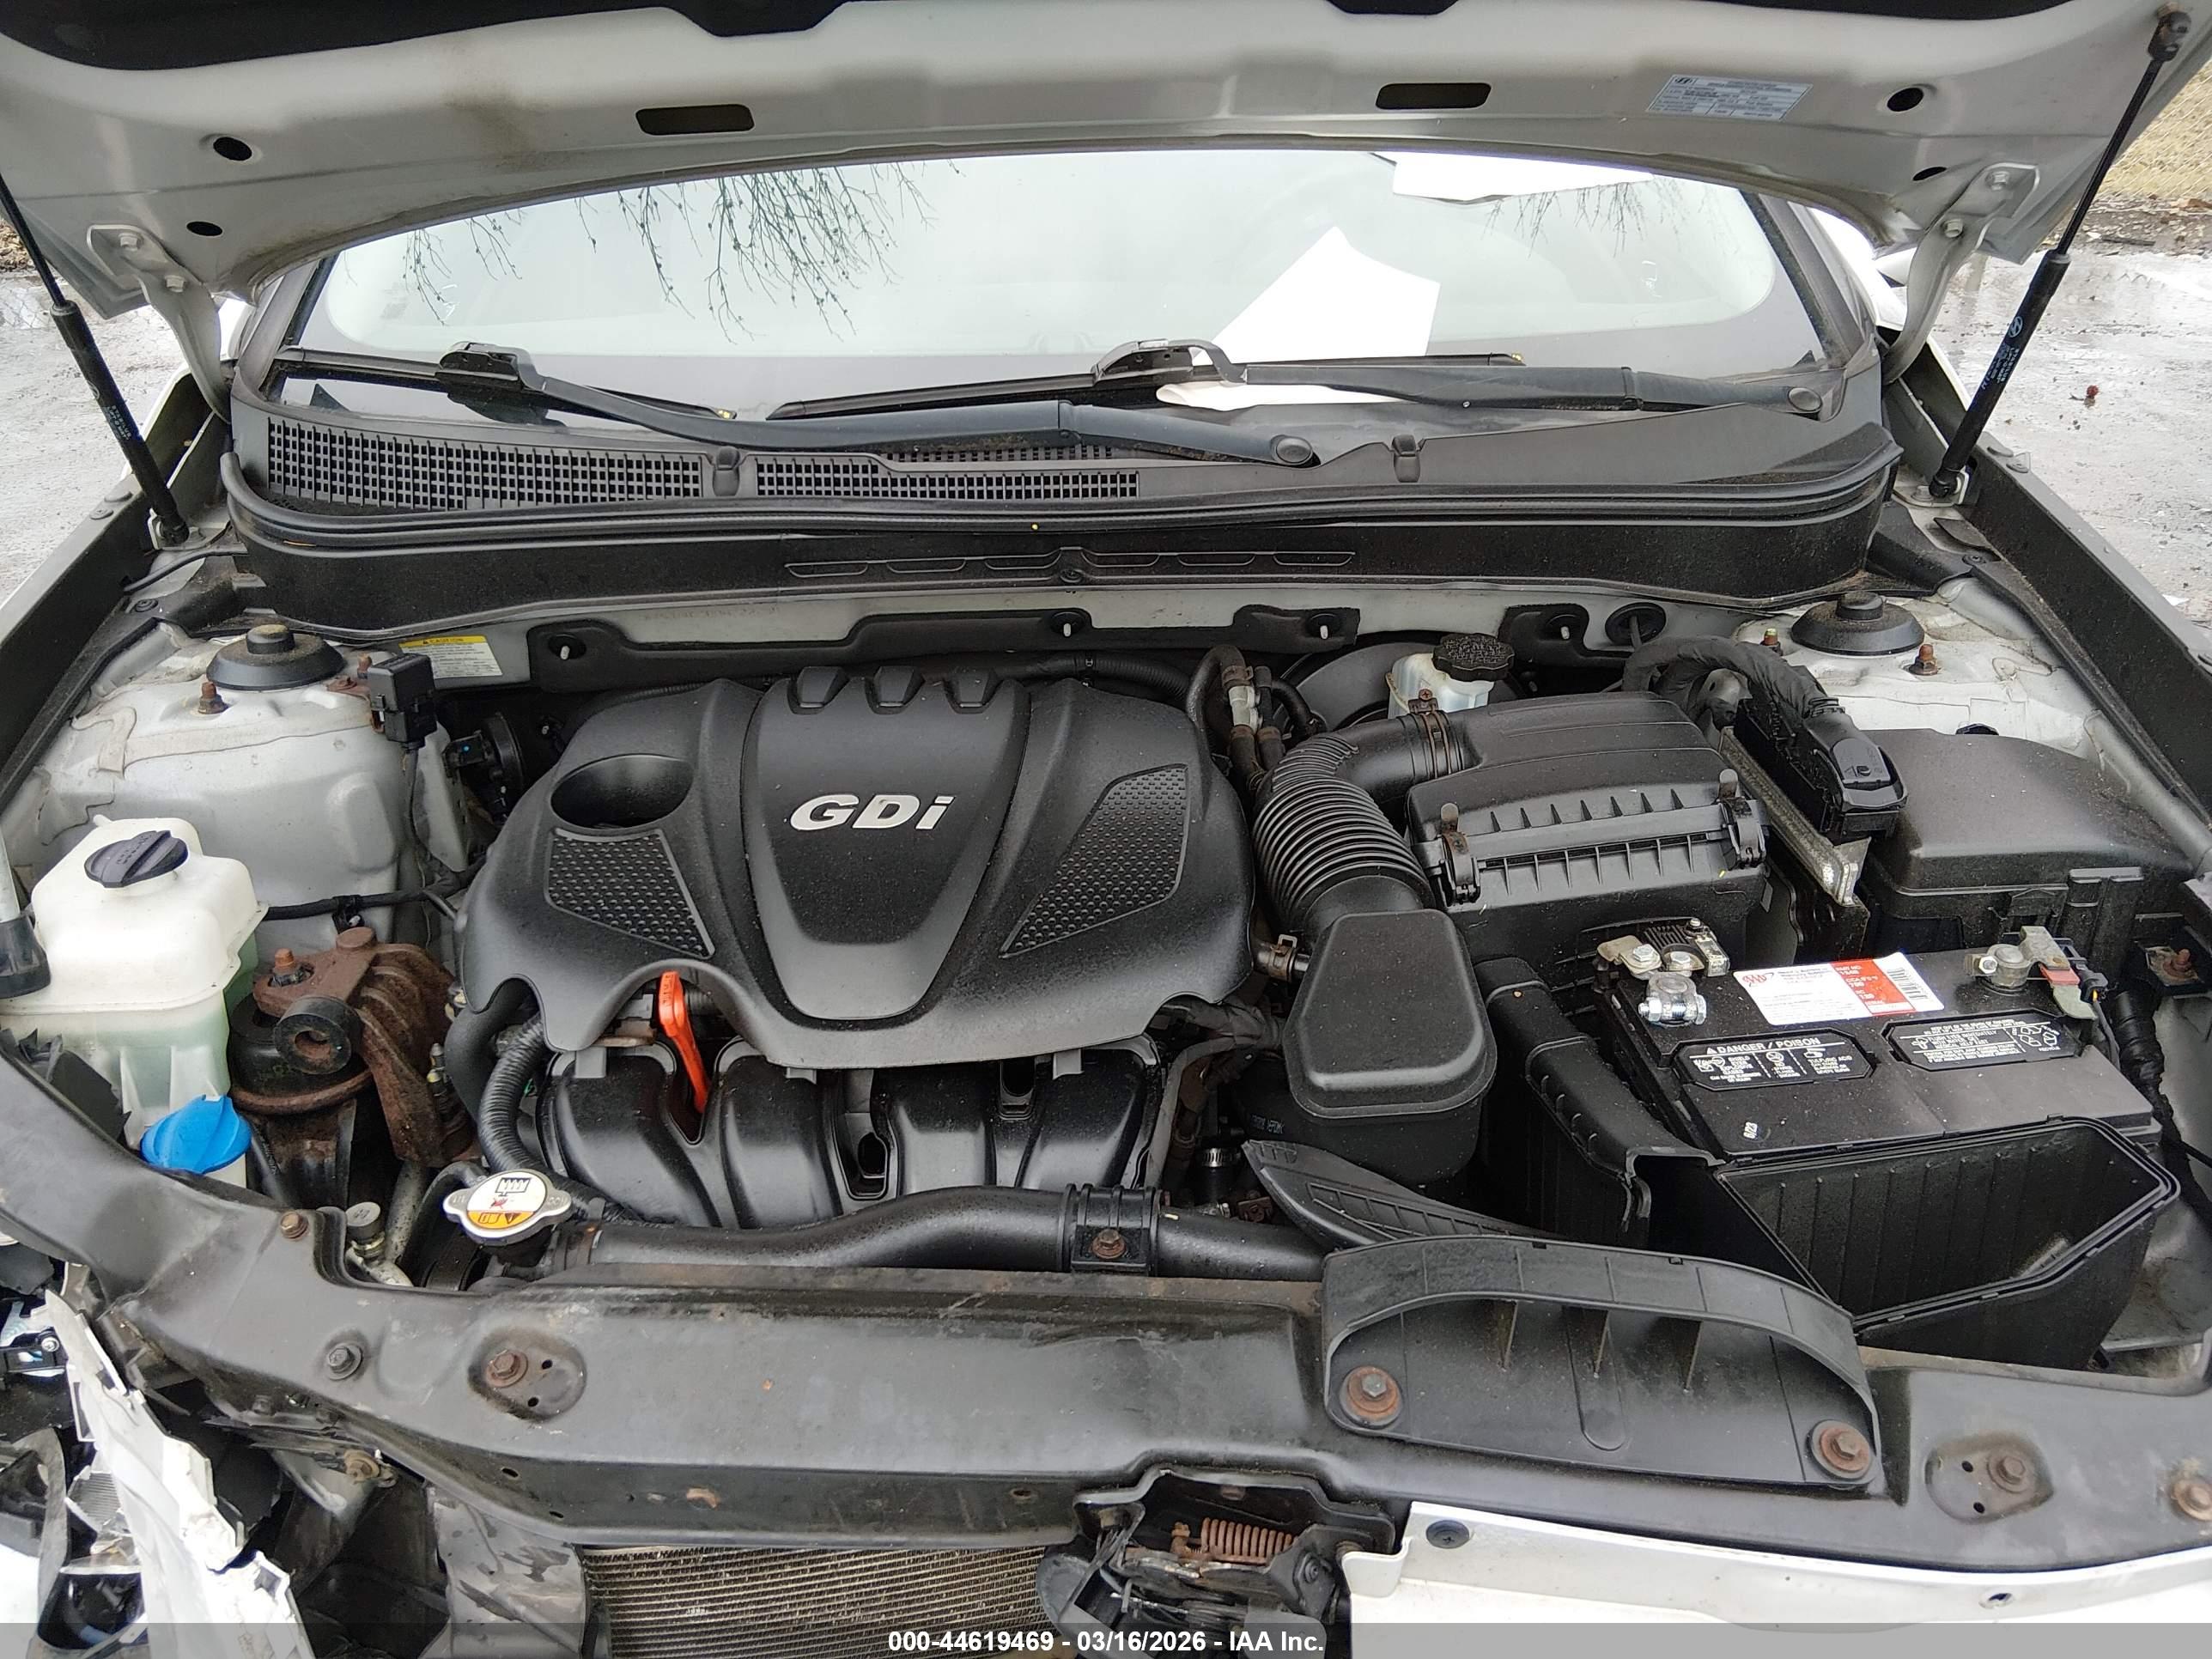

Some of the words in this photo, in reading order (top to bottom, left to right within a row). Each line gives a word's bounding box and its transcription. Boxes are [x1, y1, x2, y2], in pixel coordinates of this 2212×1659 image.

[789, 793, 957, 831] GDi
[1717, 1043, 1765, 1054] DANGER
[1767, 1041, 1773, 1049] /
[1776, 1037, 1821, 1048] POISON
